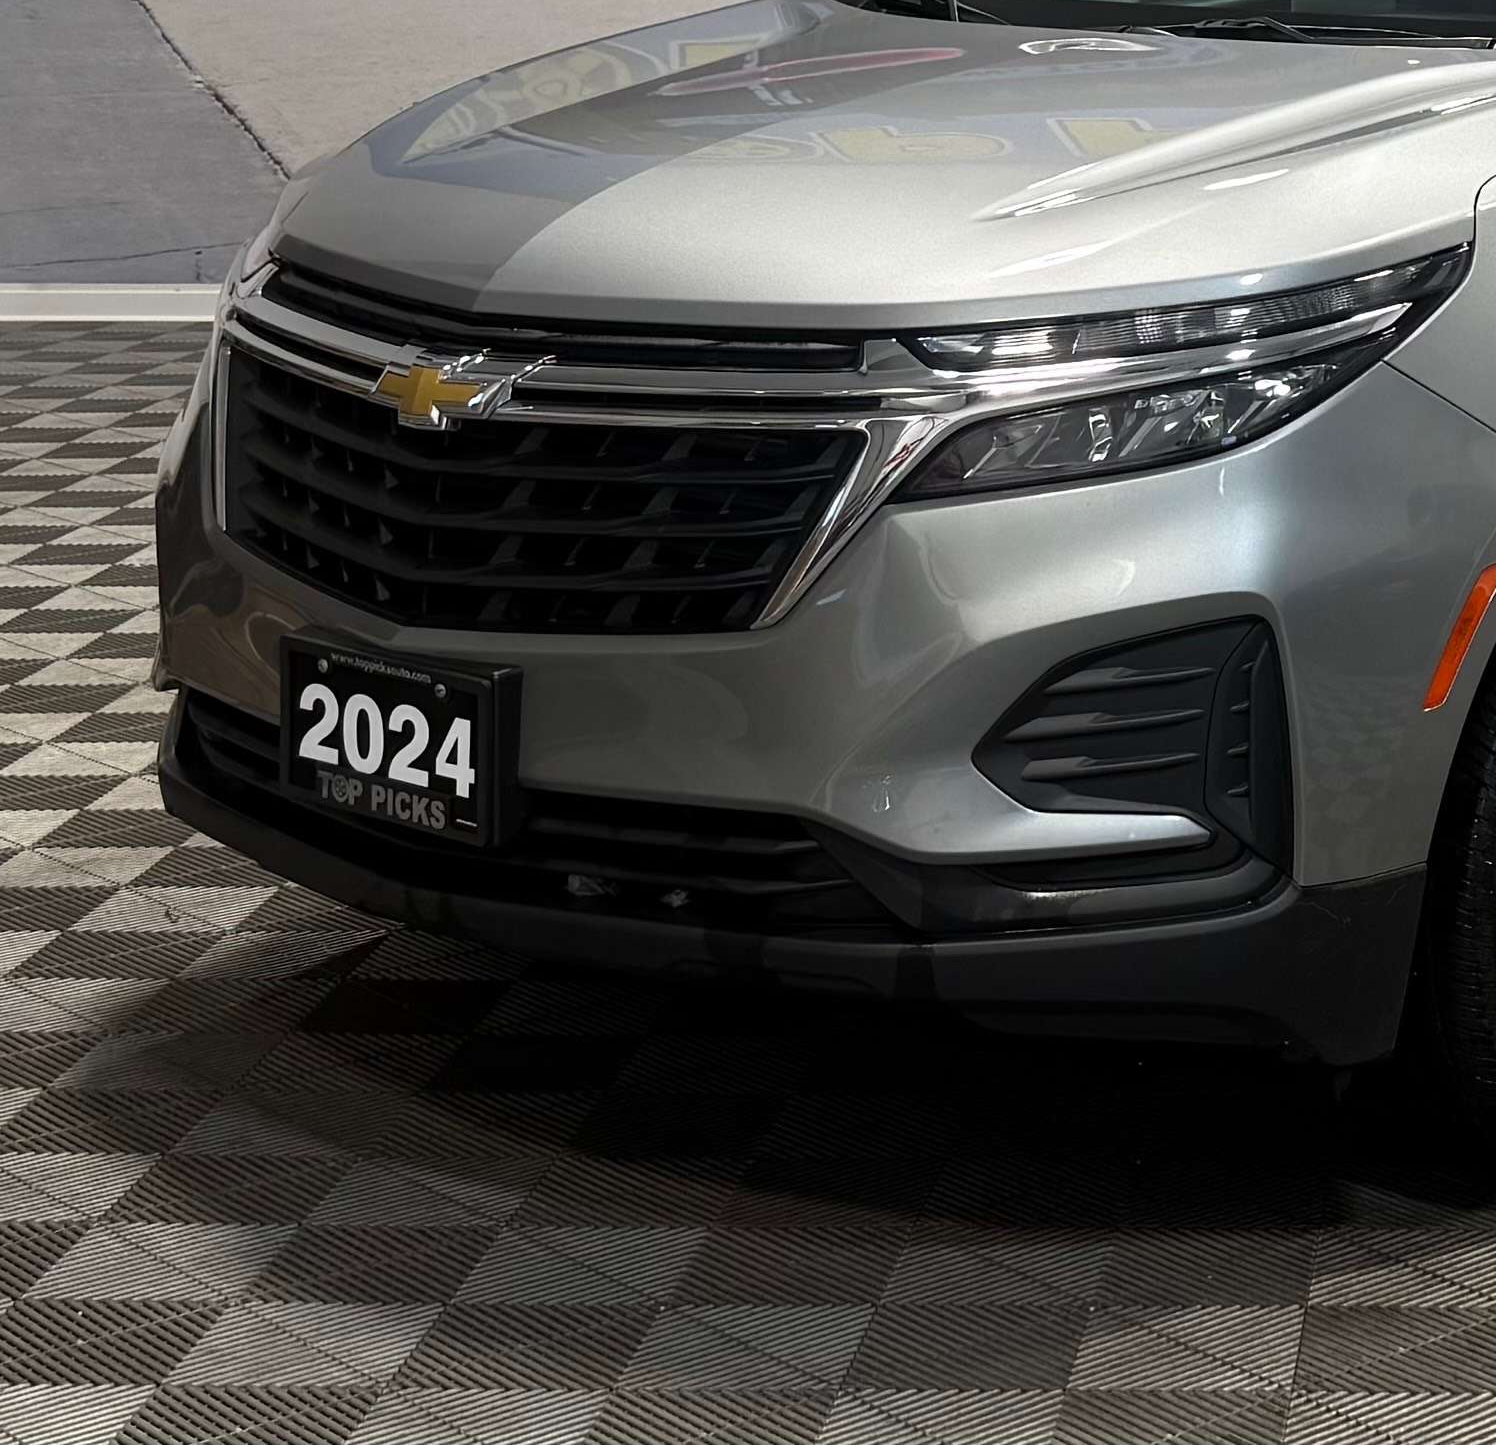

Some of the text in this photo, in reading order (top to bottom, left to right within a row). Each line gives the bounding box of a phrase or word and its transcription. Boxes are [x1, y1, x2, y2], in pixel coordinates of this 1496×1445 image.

[298, 682, 476, 799] 2024
[315, 769, 447, 830] TOP PICKS
